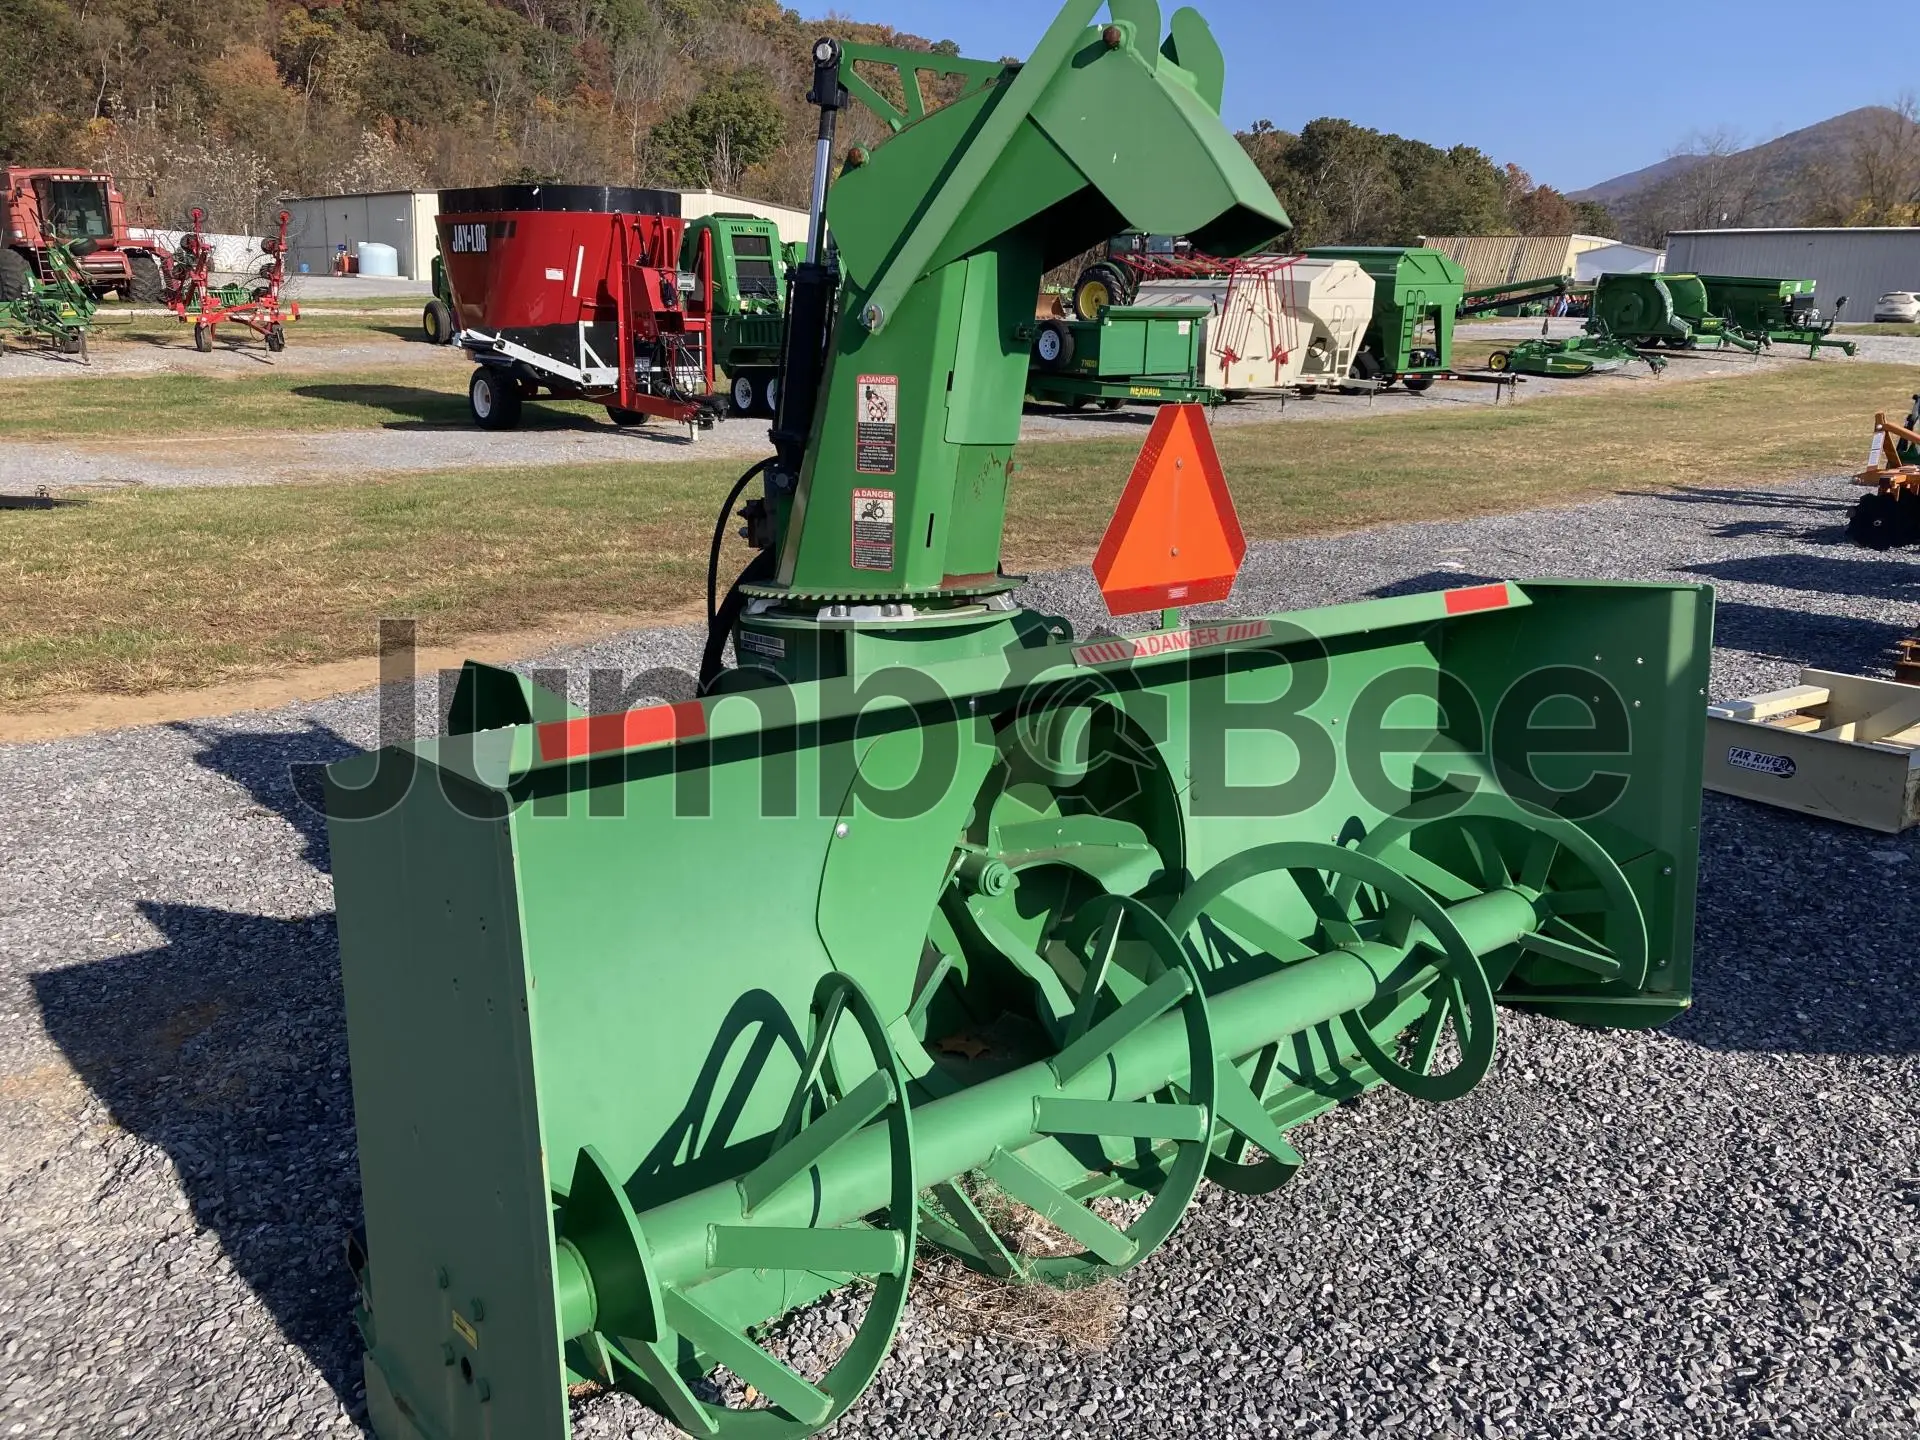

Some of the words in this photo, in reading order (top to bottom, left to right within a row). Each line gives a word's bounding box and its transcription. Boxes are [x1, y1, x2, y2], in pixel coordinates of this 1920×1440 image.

[866, 376, 896, 384] DANGER
[1129, 387, 1161, 397] NEXHAUL
[861, 490, 894, 498] DANGER
[1148, 628, 1219, 655] DANGER
[1730, 749, 1752, 760] TAR
[1753, 754, 1787, 769] RIVER
